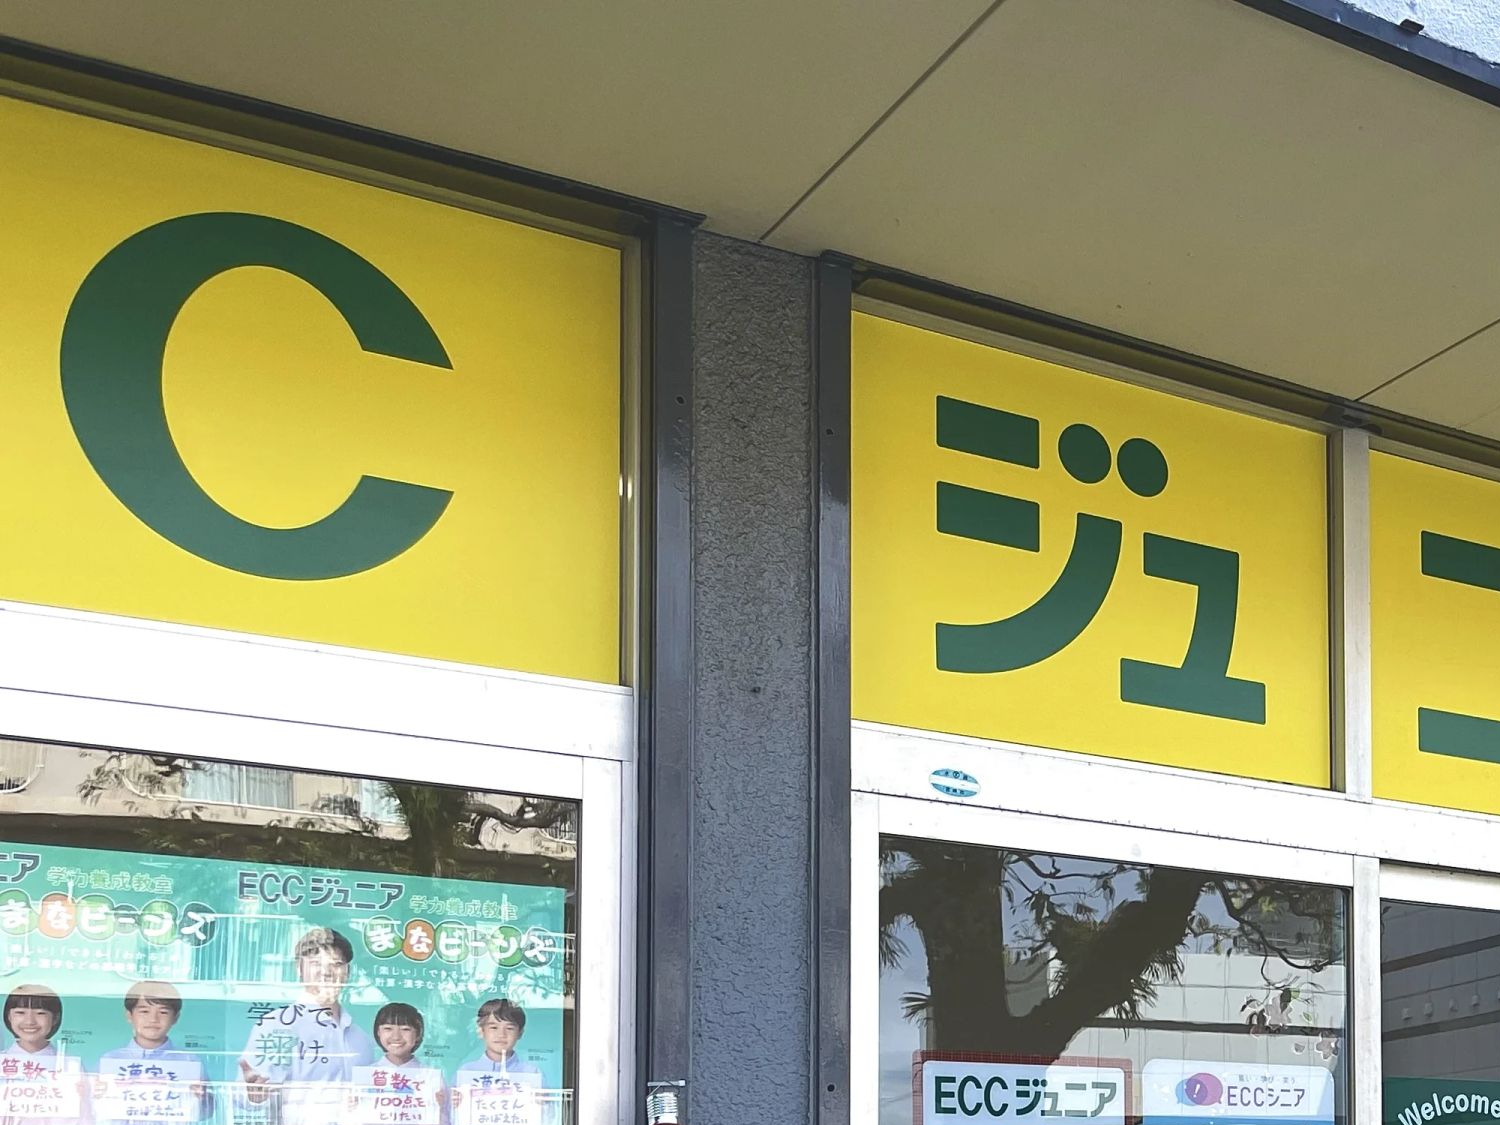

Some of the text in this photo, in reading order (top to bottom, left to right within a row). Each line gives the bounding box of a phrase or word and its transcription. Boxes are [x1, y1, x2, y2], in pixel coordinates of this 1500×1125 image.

[238, 871, 404, 911] ECCジュニア
[934, 1075, 1118, 1118] ECCジュニア
[1227, 1086, 1306, 1108] ECCシニア
